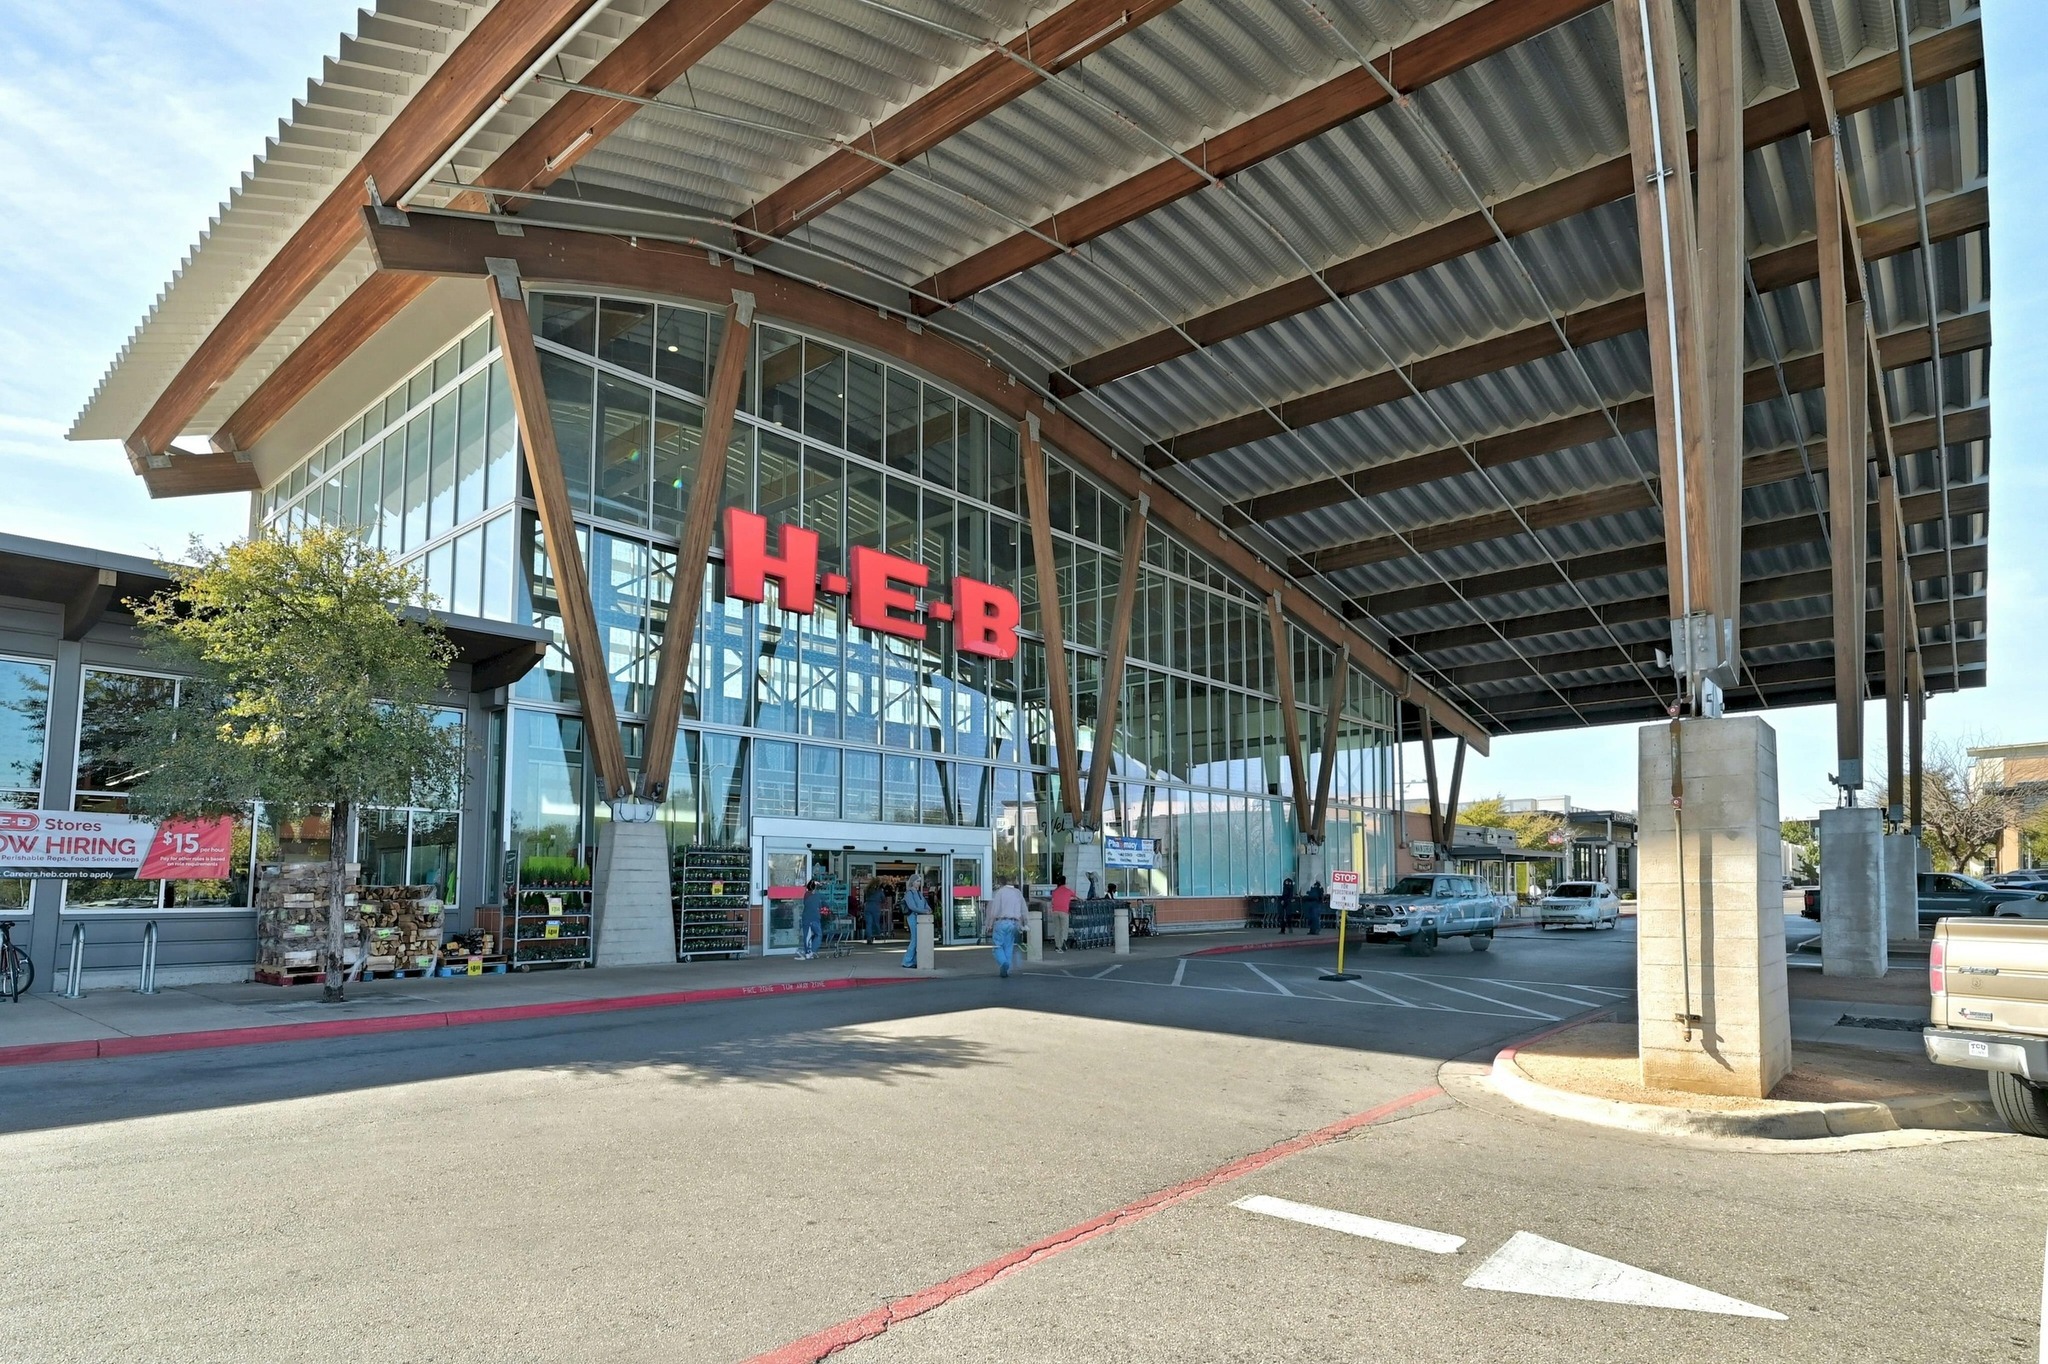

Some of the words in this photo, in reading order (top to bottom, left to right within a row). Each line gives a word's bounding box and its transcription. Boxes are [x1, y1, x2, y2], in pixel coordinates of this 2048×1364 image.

[723, 507, 1020, 661] H-E-B
[45, 818, 102, 831] Stores
[46, 836, 136, 855] HIRING
[163, 831, 199, 854] $15
[3, 870, 77, 878] Careers.heb.com
[1334, 873, 1357, 882] STOP
